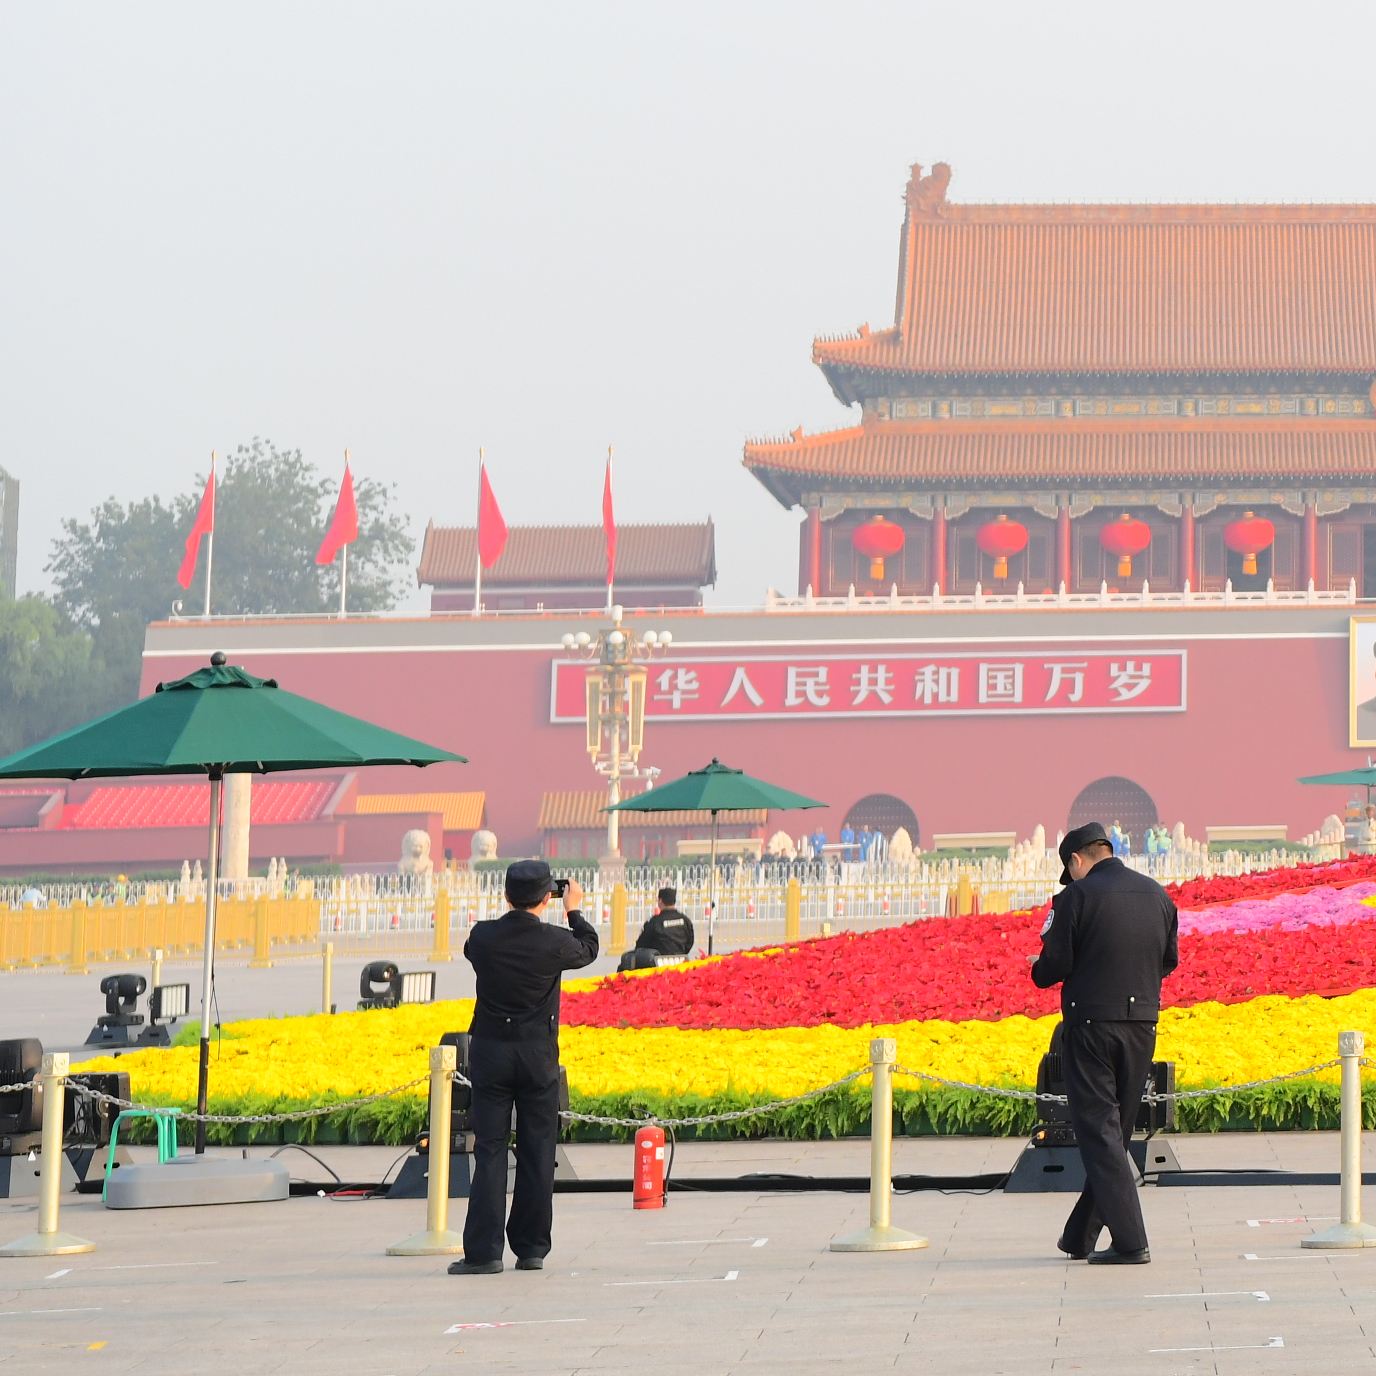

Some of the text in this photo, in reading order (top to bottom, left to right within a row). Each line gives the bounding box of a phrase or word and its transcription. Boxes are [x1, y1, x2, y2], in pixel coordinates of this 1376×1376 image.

[602, 660, 1153, 709] 华人民共和国万岁
